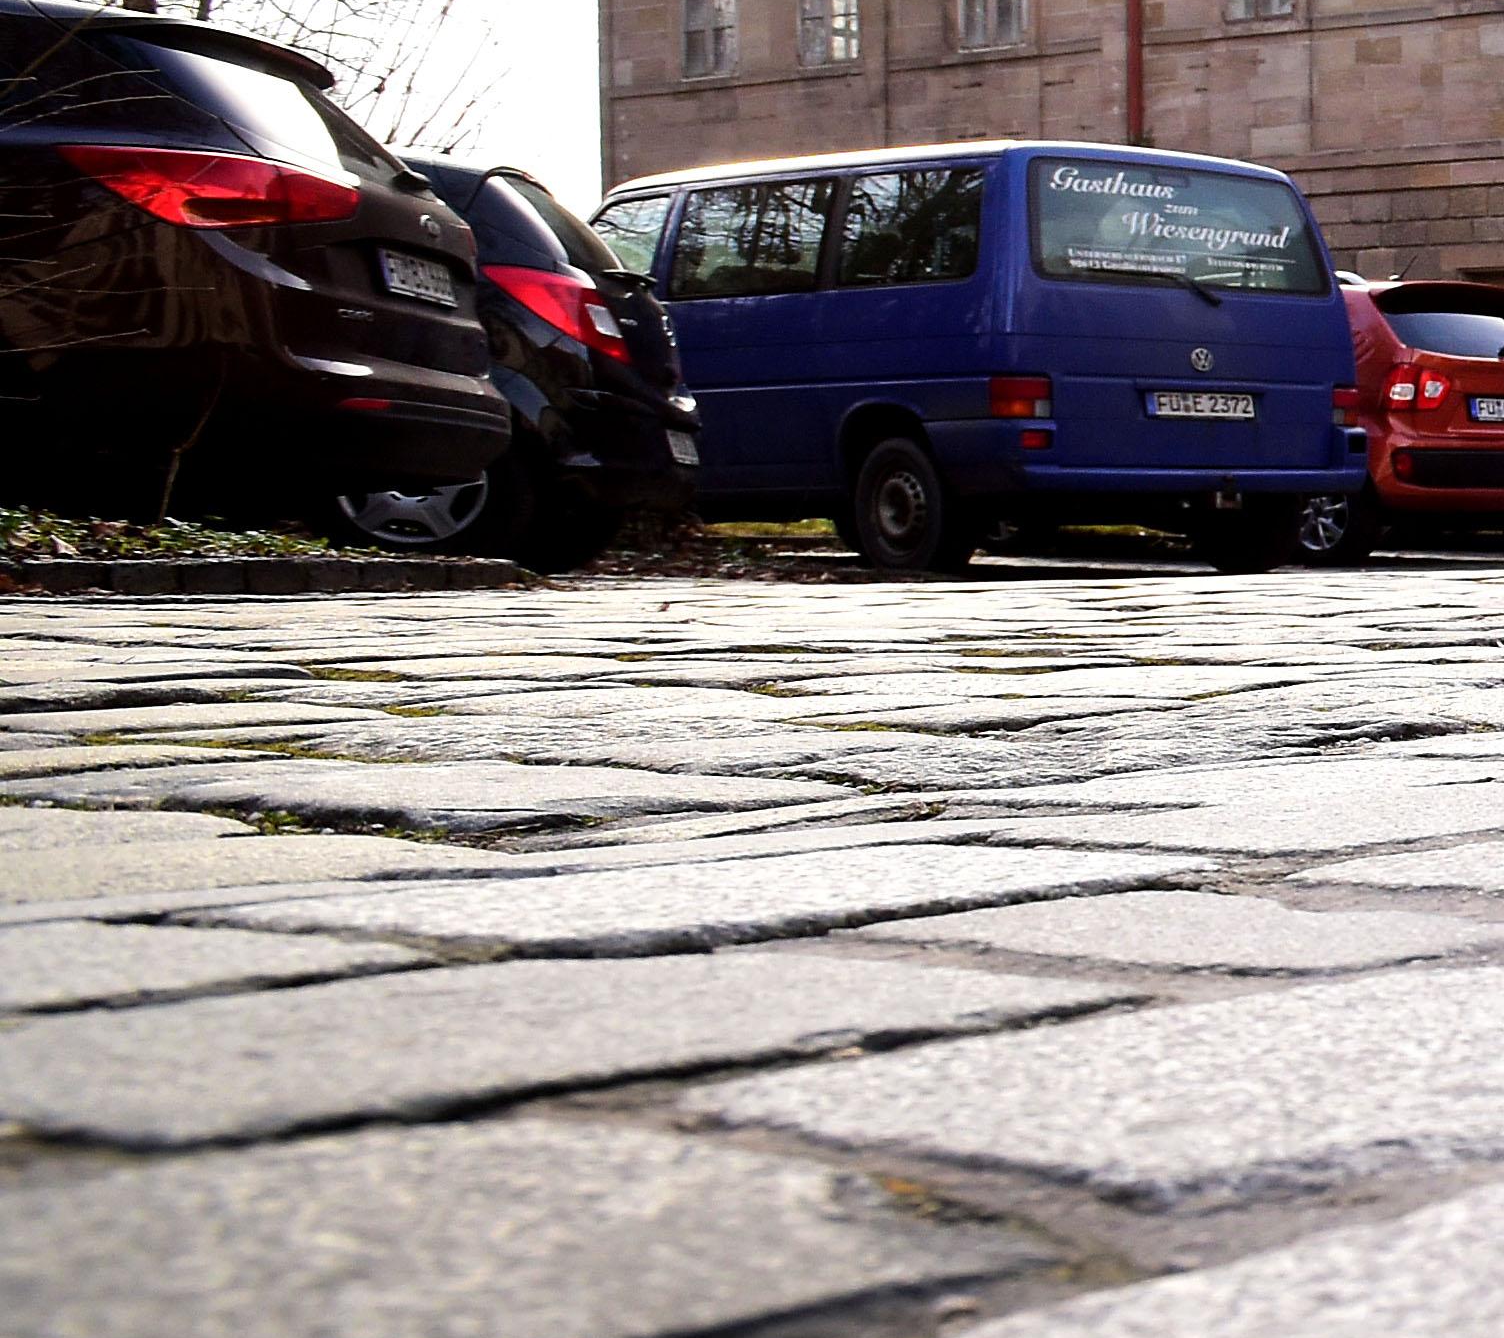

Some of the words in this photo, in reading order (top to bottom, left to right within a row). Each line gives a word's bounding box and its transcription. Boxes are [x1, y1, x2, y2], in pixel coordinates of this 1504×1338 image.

[1050, 166, 1175, 199] Gasthaus
[1163, 203, 1199, 216] zum
[1121, 212, 1290, 251] Wiesengrund
[1192, 395, 1203, 413] E
[1208, 395, 1252, 414] 2372
